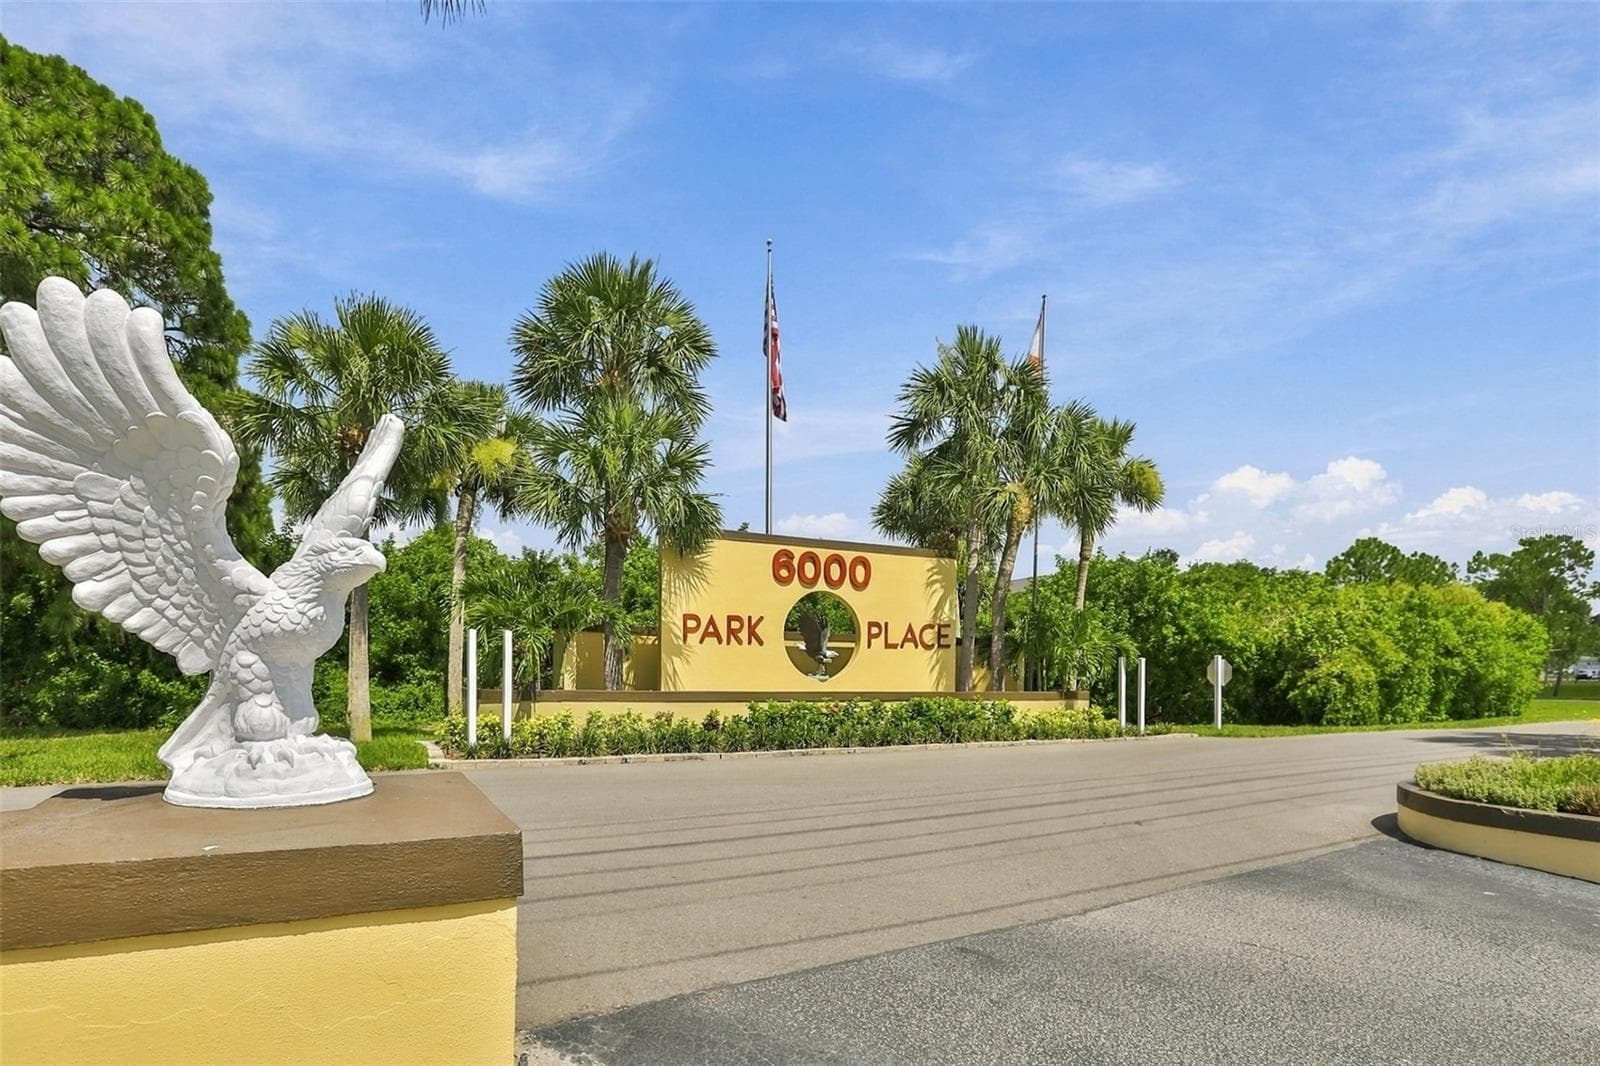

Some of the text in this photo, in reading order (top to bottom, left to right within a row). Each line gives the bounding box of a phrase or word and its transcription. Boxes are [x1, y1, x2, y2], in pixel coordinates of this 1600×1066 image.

[772, 549, 871, 590] 6000
[682, 613, 951, 649] PARK PLACE
